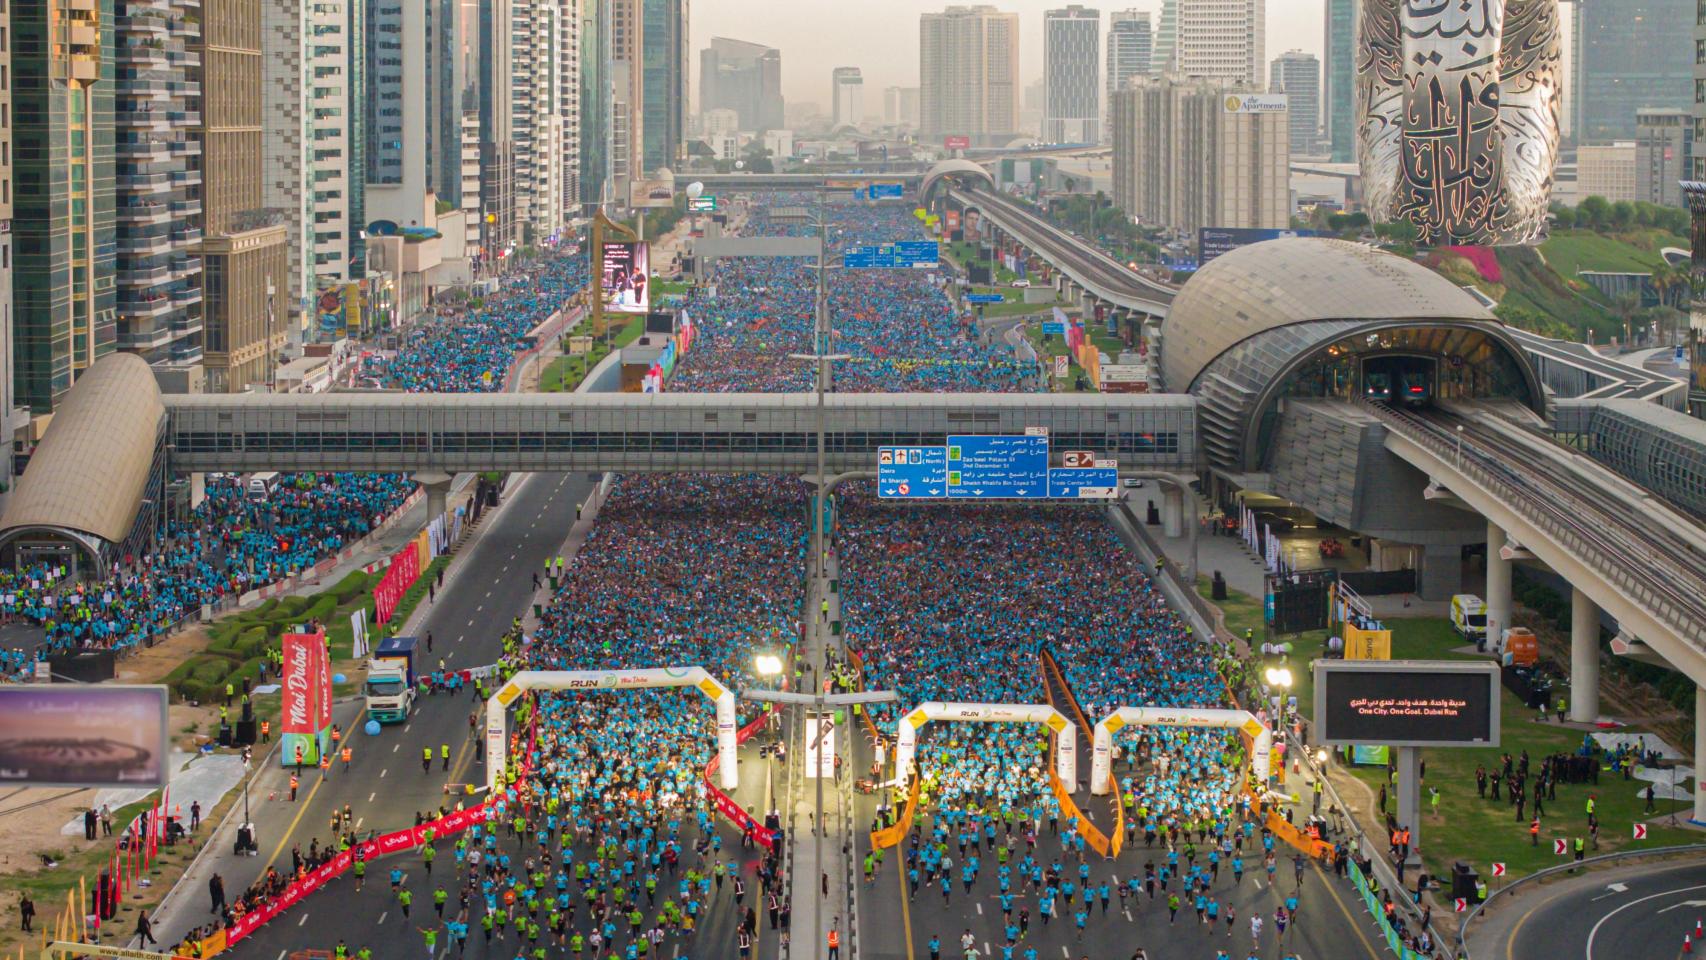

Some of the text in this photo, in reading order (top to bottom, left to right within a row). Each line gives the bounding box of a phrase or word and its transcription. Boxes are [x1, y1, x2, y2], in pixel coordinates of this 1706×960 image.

[1240, 102, 1286, 111] Apartments
[288, 642, 307, 725] Mai Dubai
[100, 949, 162, 960] www.allaith.com
